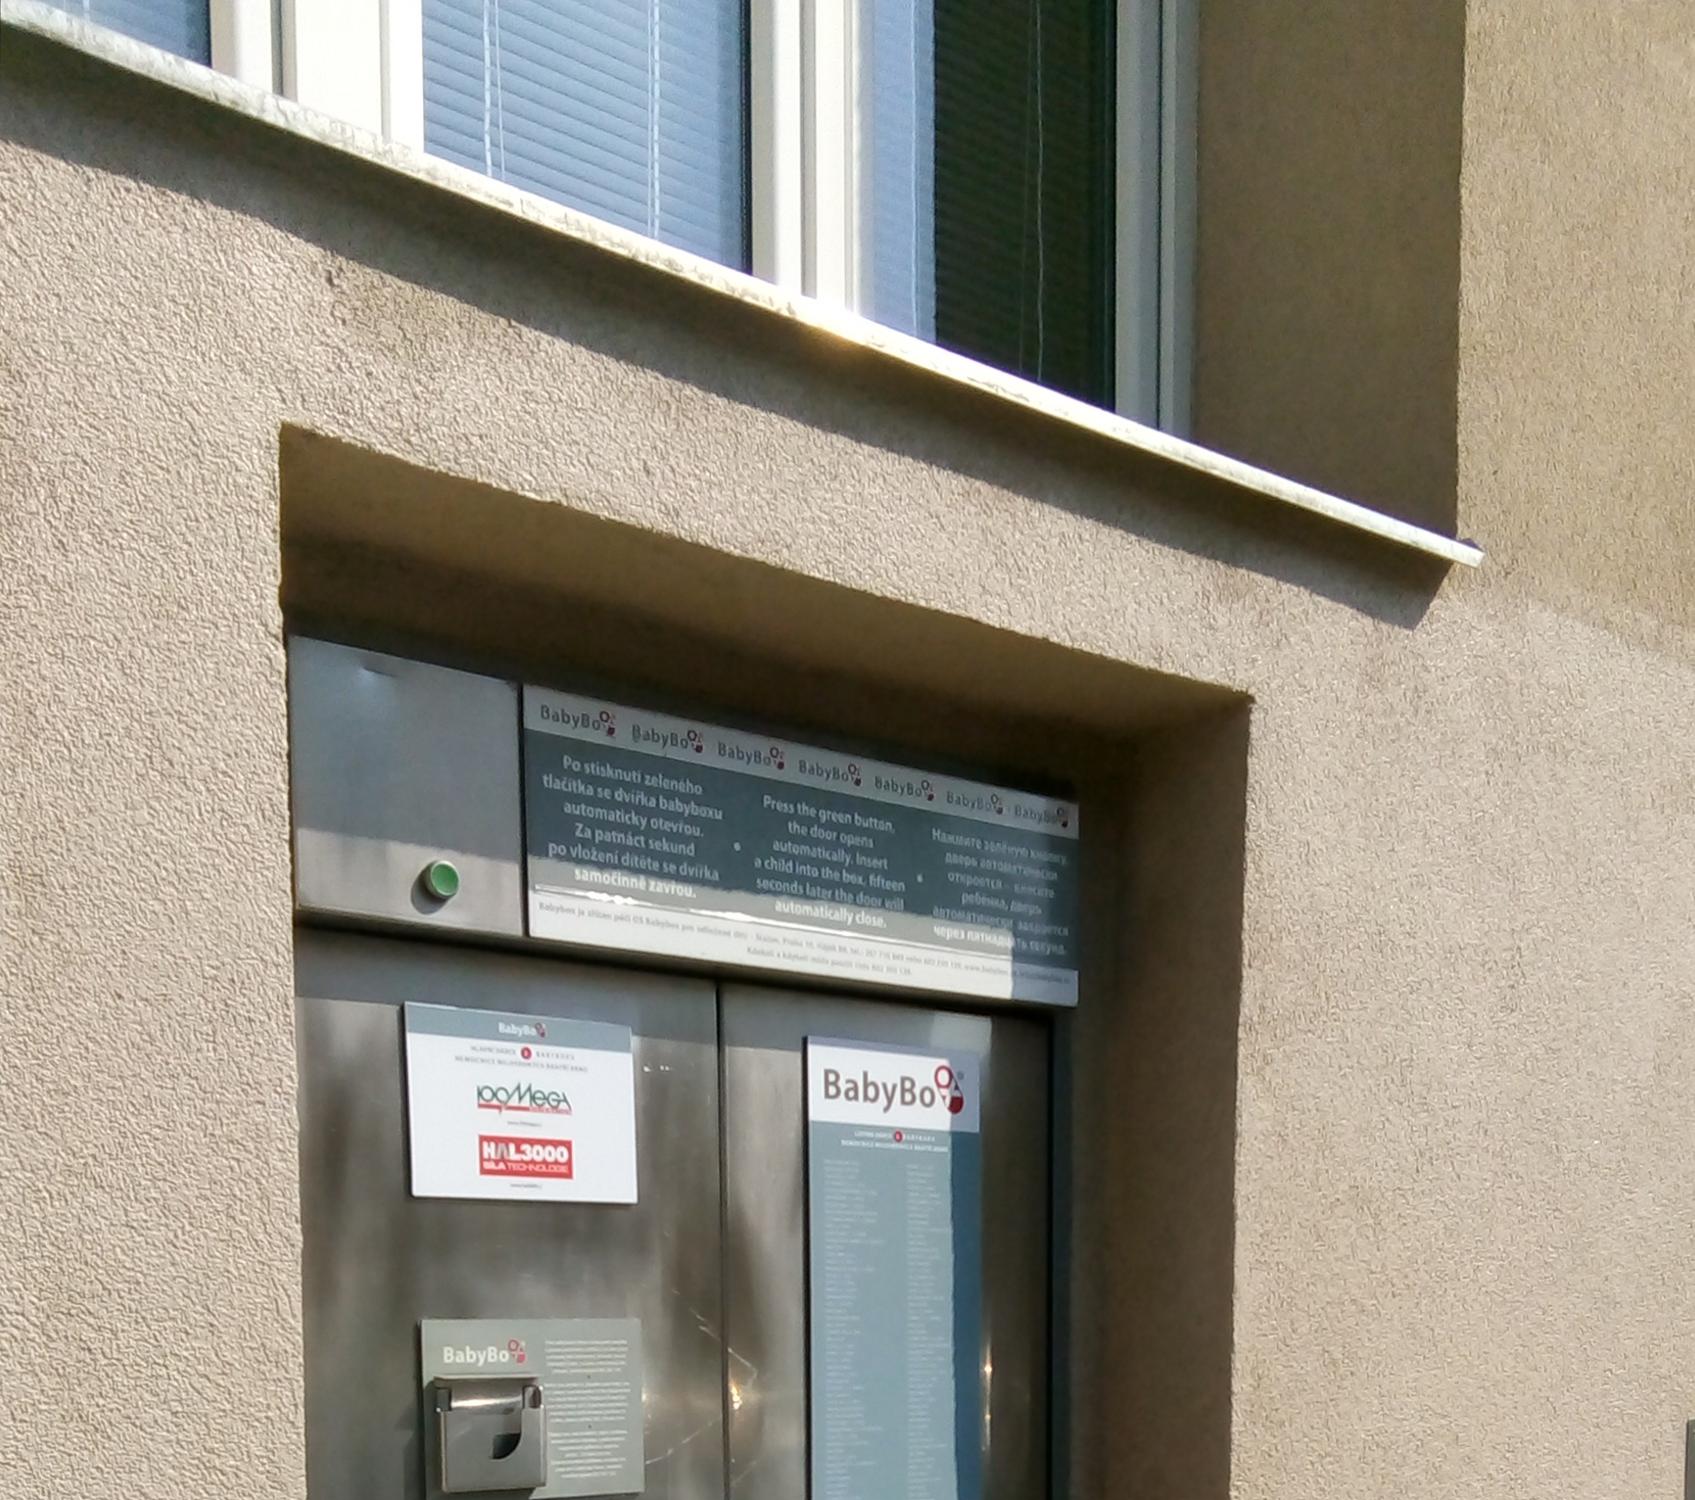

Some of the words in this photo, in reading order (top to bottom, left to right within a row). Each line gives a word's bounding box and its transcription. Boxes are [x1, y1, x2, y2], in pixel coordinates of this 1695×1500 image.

[563, 754, 581, 771] Po
[564, 801, 647, 830] automaticky
[597, 787, 611, 799] se
[659, 795, 723, 820] babyboxu
[763, 795, 795, 814] Press
[797, 802, 817, 818] the
[819, 809, 852, 824] green
[854, 812, 895, 834] button,
[575, 822, 591, 839] Za
[595, 828, 645, 848] patnáct
[649, 836, 695, 857] sekund
[788, 820, 808, 836] the
[810, 824, 837, 840] door
[840, 834, 874, 849] opens
[548, 842, 567, 857] po
[663, 861, 677, 873] se
[856, 853, 888, 870] Insert
[574, 868, 647, 890] samočinně
[754, 857, 762, 868] a
[764, 856, 793, 874] child
[795, 861, 819, 878] into
[821, 866, 841, 881] the
[869, 873, 906, 892] fifteen
[756, 877, 803, 895] seconds
[806, 882, 833, 899] later
[835, 887, 854, 902] the
[856, 890, 882, 907] door
[775, 900, 853, 926] automatically
[855, 910, 888, 928] close.
[482, 1141, 569, 1164] HAL3000
